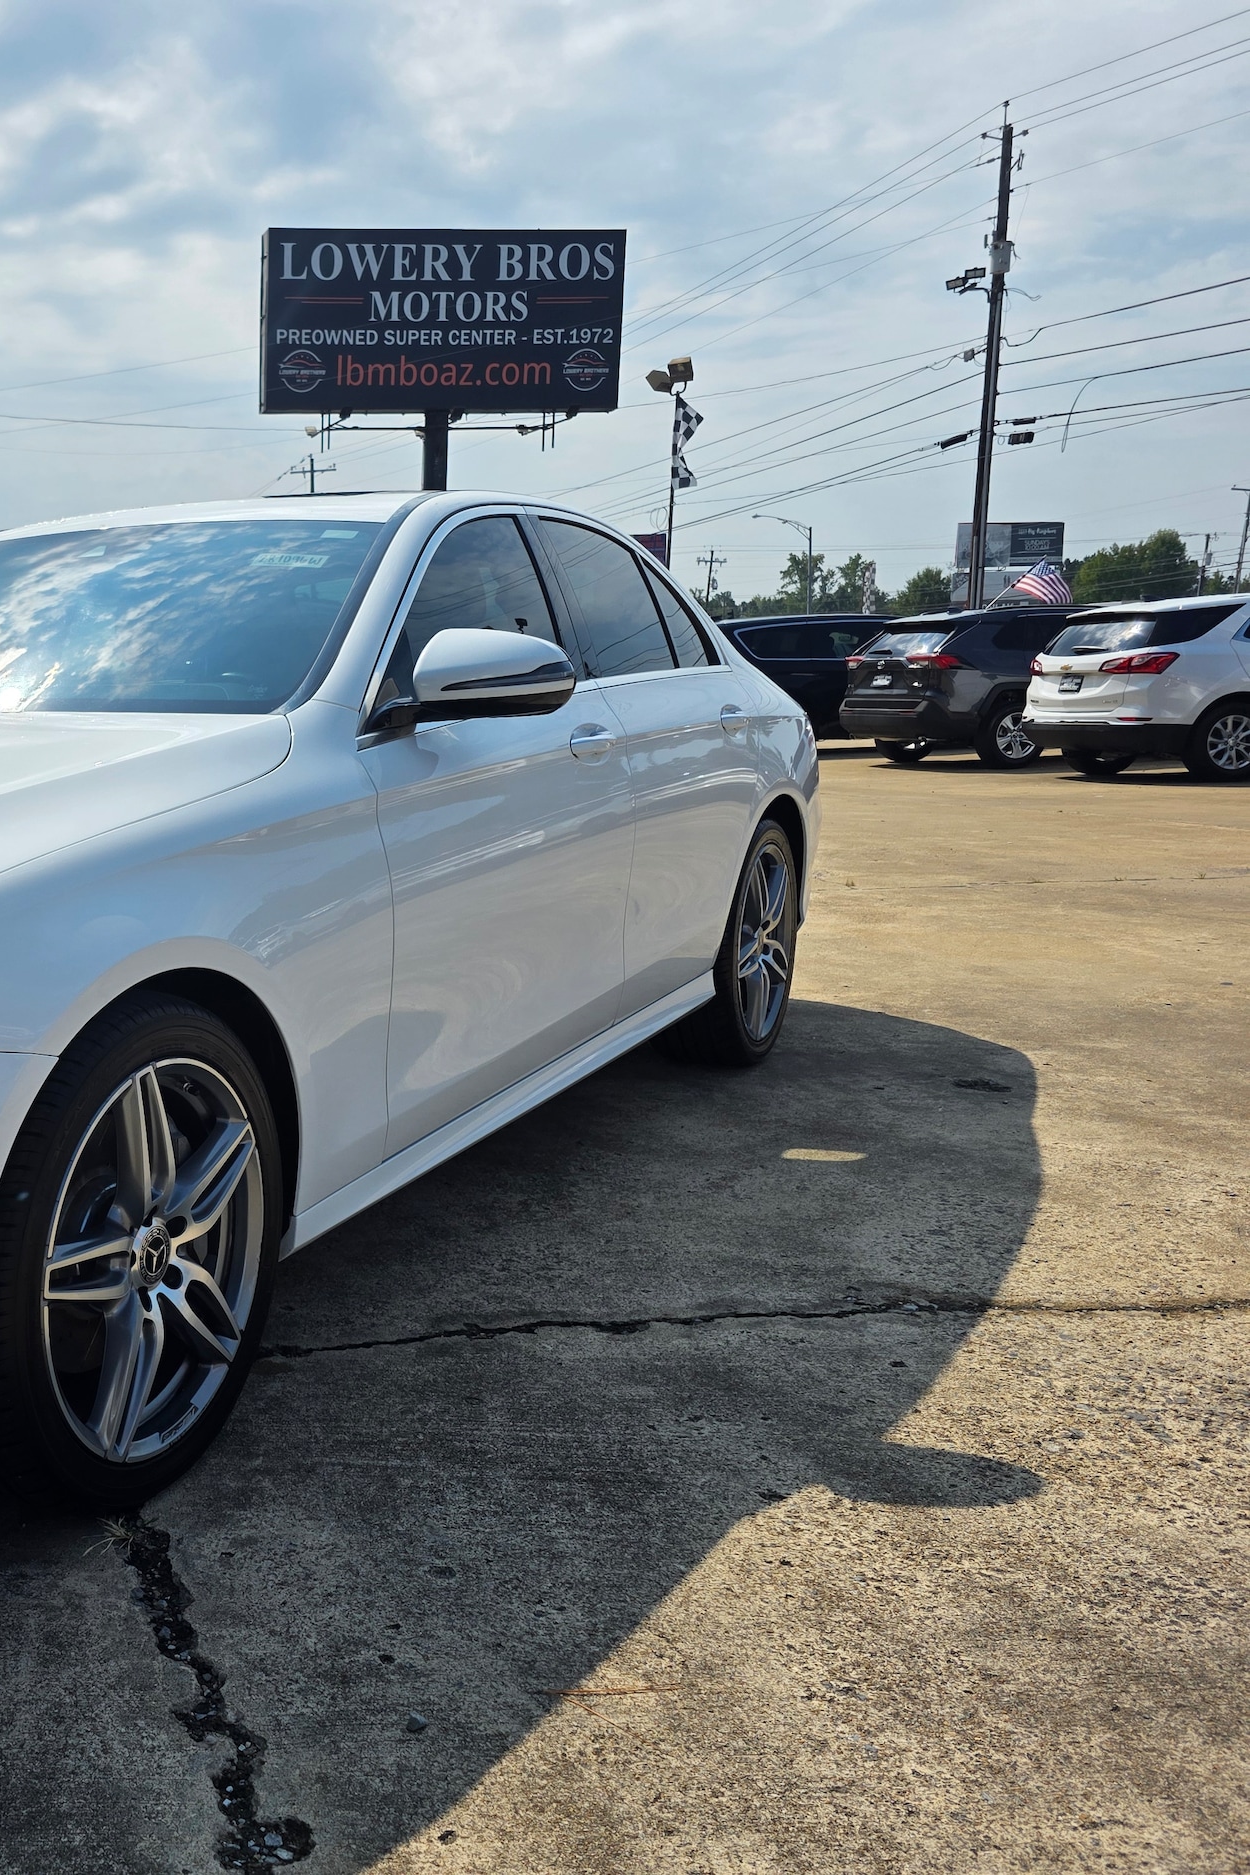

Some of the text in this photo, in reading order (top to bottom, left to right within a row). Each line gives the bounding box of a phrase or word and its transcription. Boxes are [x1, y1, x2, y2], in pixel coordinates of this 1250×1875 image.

[279, 242, 615, 281] LOWERY BROS
[368, 290, 529, 322] MOTORS
[276, 329, 379, 346] PREOWNED
[383, 329, 442, 346] SUPER
[449, 329, 516, 345] CENTER
[532, 328, 614, 345] EST.1972
[337, 355, 551, 386] lbmboaz.com
